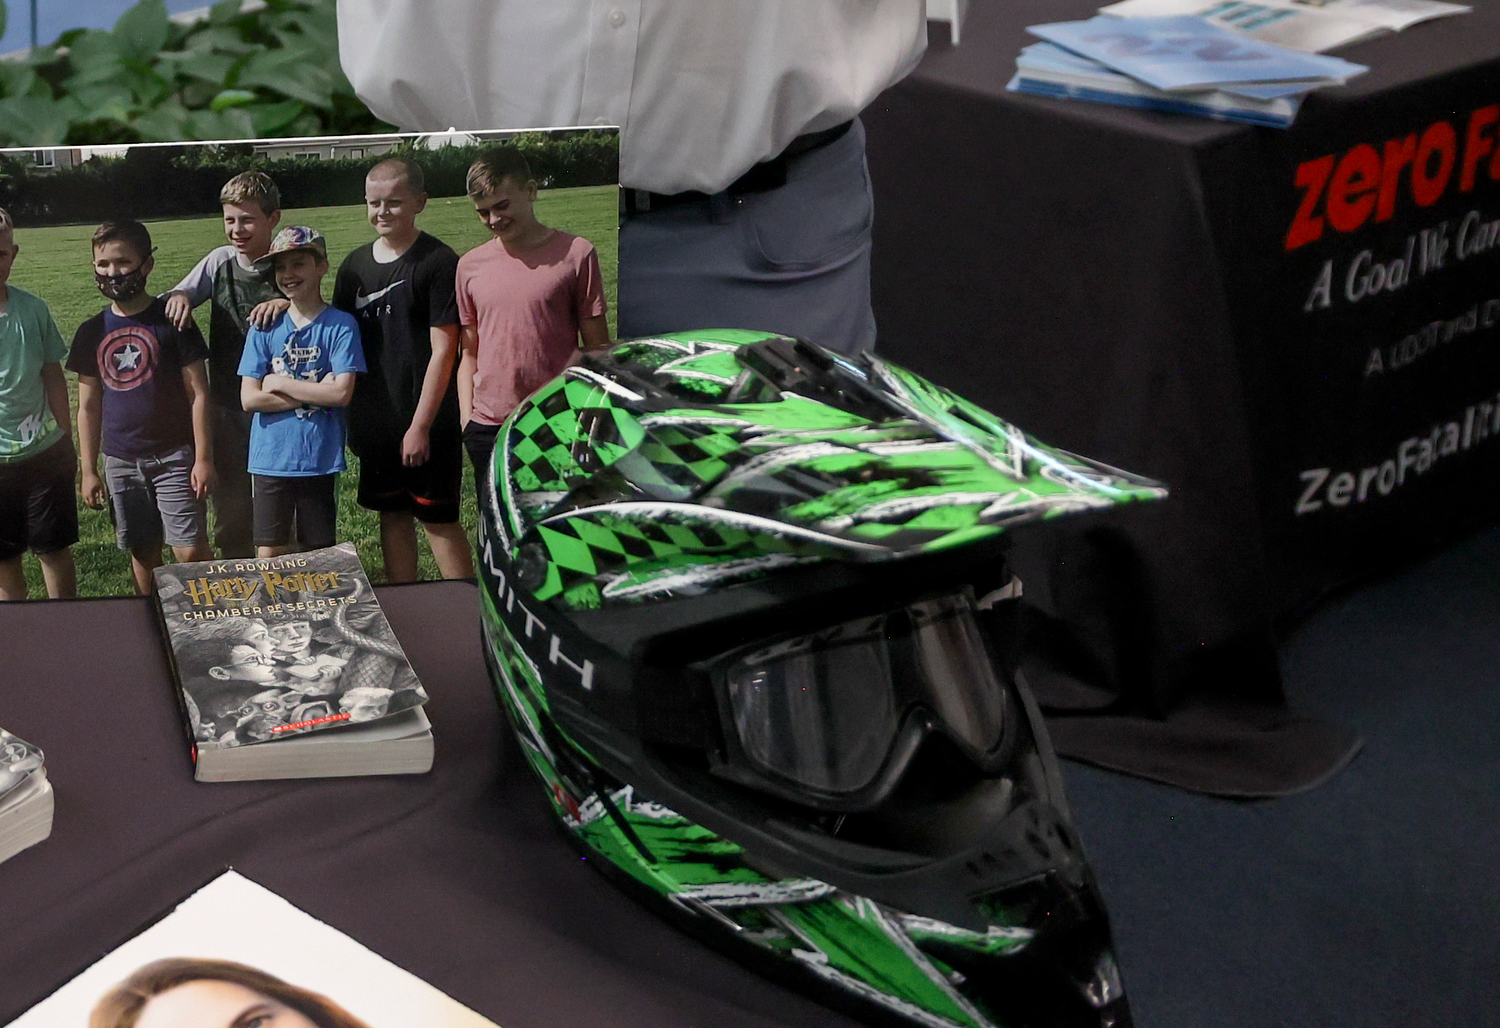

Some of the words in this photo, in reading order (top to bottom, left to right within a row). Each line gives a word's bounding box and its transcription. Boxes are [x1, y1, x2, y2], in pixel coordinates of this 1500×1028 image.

[1305, 259, 1332, 312] A
[1346, 234, 1415, 302] Goal
[1419, 222, 1449, 276] We
[363, 305, 391, 318] AIR
[1365, 348, 1384, 376] A
[206, 565, 232, 574] J.K.
[236, 558, 308, 572] ROWLING
[183, 576, 258, 607] Harry
[260, 572, 340, 602] Potter
[183, 608, 262, 621] CHAMBER
[268, 604, 283, 613] OF
[287, 596, 358, 612] SECRETS
